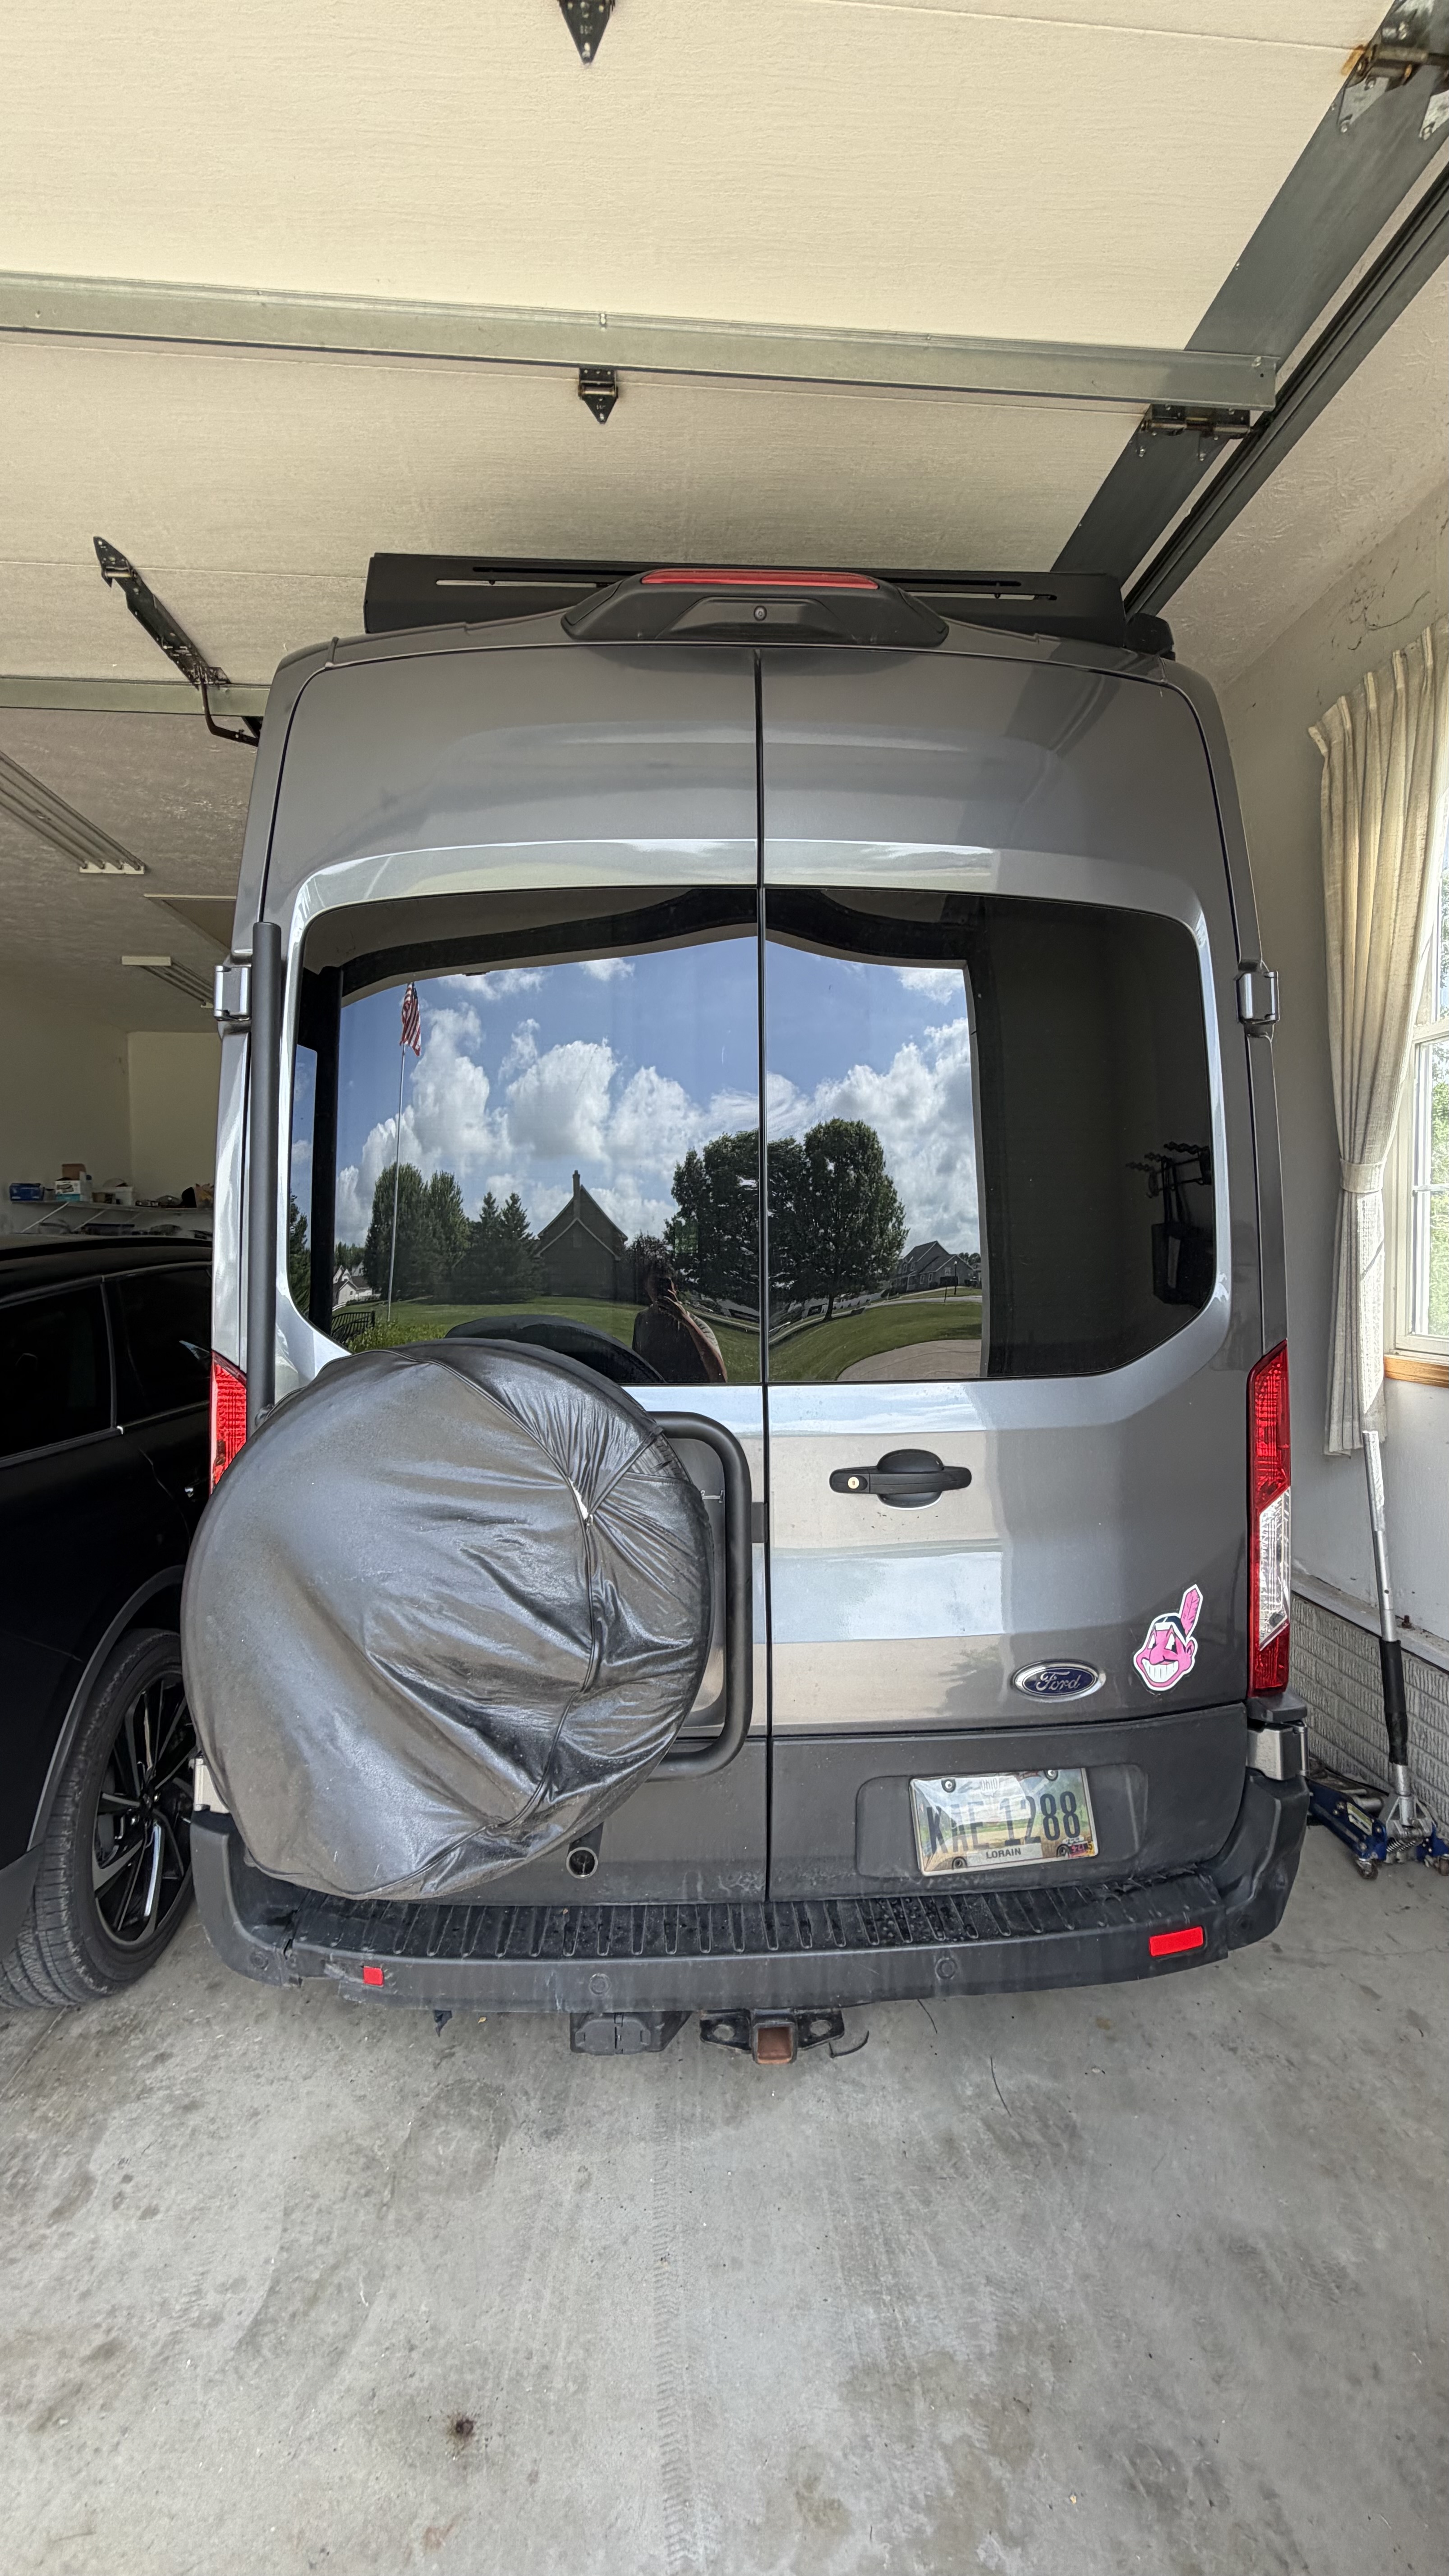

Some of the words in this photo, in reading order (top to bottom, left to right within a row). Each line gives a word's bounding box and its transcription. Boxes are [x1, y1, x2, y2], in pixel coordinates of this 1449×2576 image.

[1036, 1671, 1081, 1691] Ford
[999, 1791, 1081, 1846] 1288
[986, 1848, 1021, 1858] LORAIN
